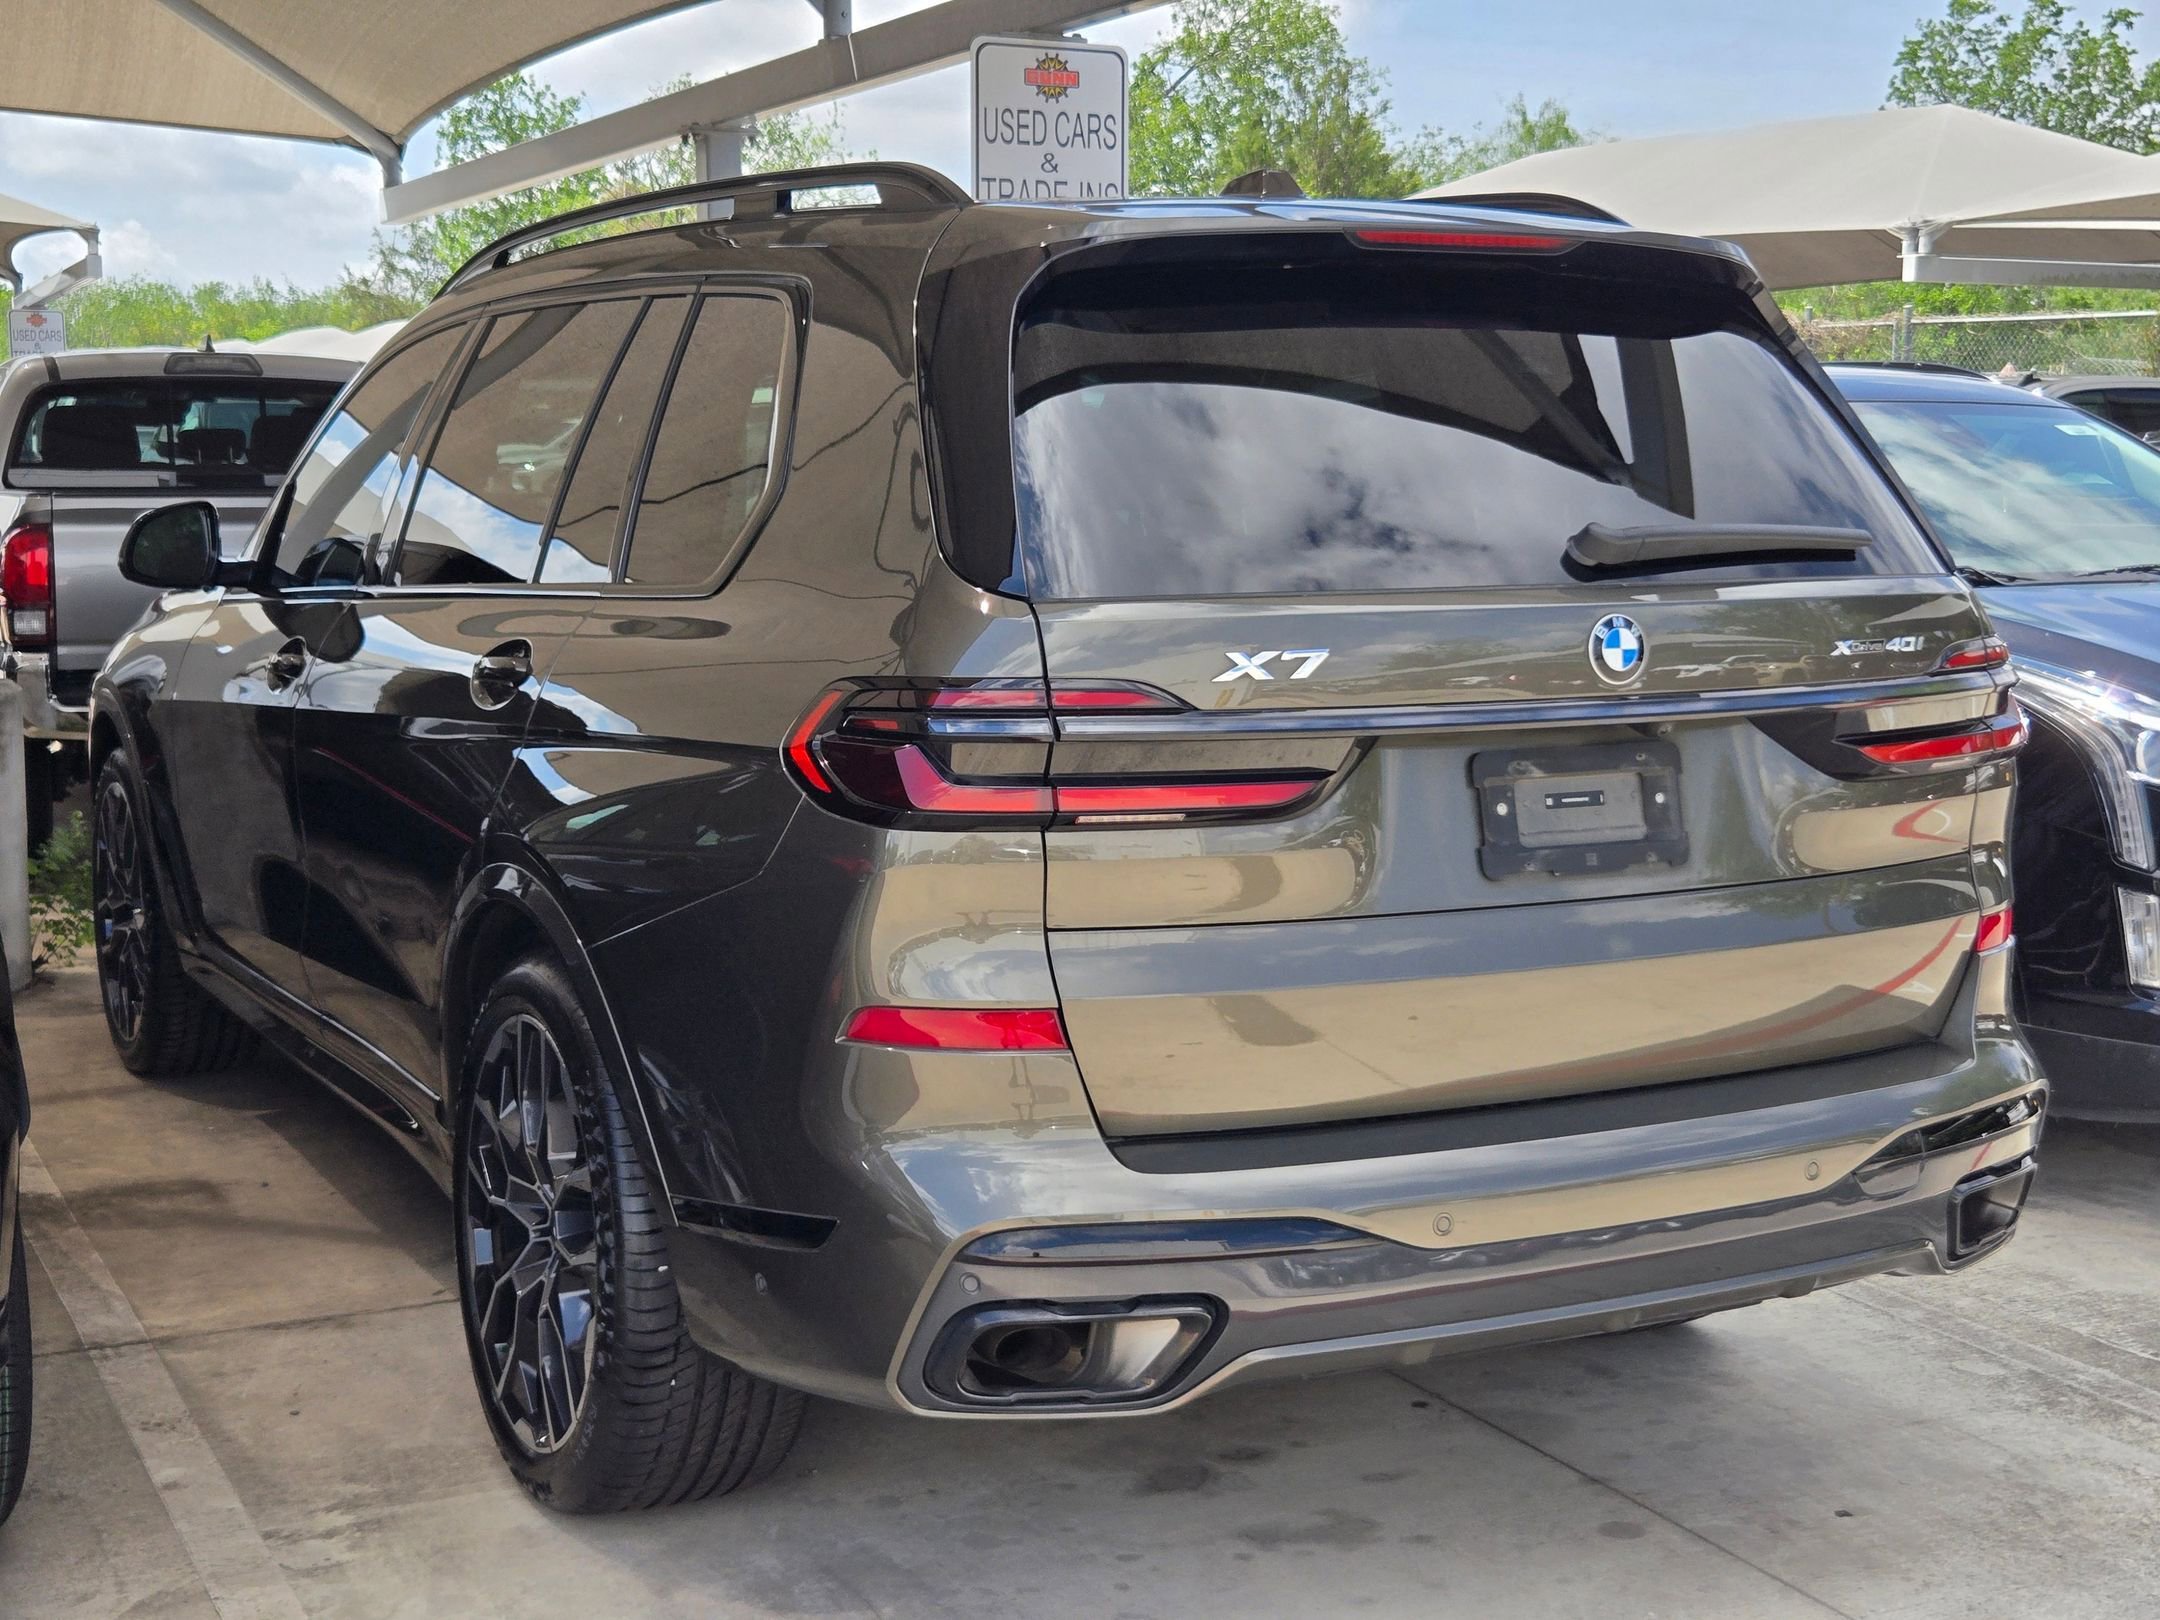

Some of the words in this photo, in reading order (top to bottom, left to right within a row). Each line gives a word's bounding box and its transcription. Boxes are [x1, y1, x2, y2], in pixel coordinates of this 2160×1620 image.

[984, 107, 1047, 146] USED
[1055, 111, 1117, 150] CARS
[1040, 152, 1059, 173] &
[12, 329, 36, 341] USED
[38, 330, 62, 342] CARS
[1595, 616, 1641, 640] BMW
[1210, 648, 1330, 682] X7
